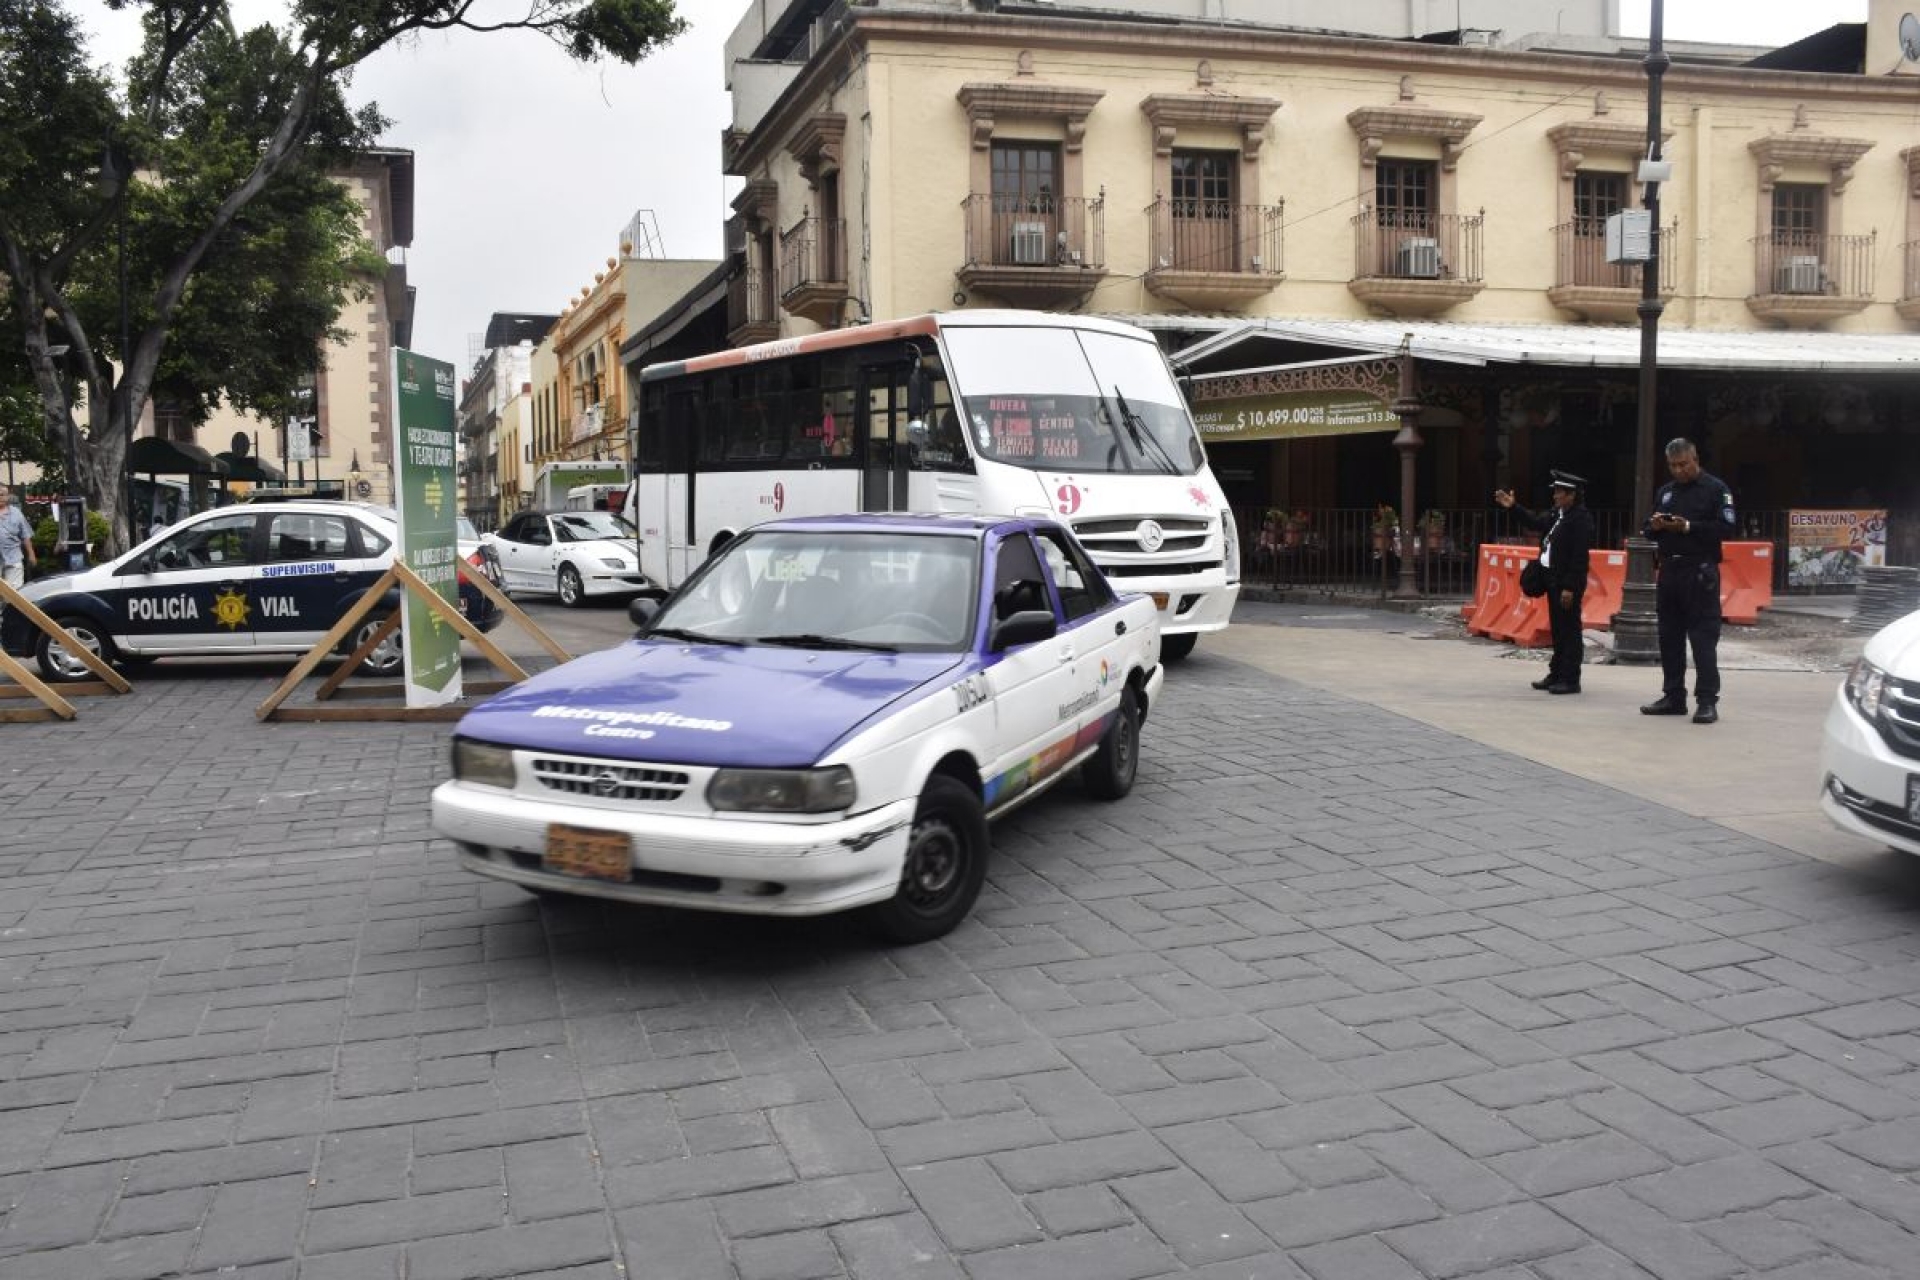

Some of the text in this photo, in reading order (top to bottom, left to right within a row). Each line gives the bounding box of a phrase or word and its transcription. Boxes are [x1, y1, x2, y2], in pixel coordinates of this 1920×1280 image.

[990, 398, 1027, 412] RIVERA
[1249, 408, 1308, 428] 10,499.00
[774, 482, 784, 513] 9
[1057, 484, 1081, 515] 9
[1791, 513, 1857, 526] DESAYUNO
[262, 562, 335, 577] SUPERVISION
[128, 593, 300, 620] POLICÍA VIAL
[531, 705, 733, 732] Metropolitano
[583, 724, 656, 739] Centro
